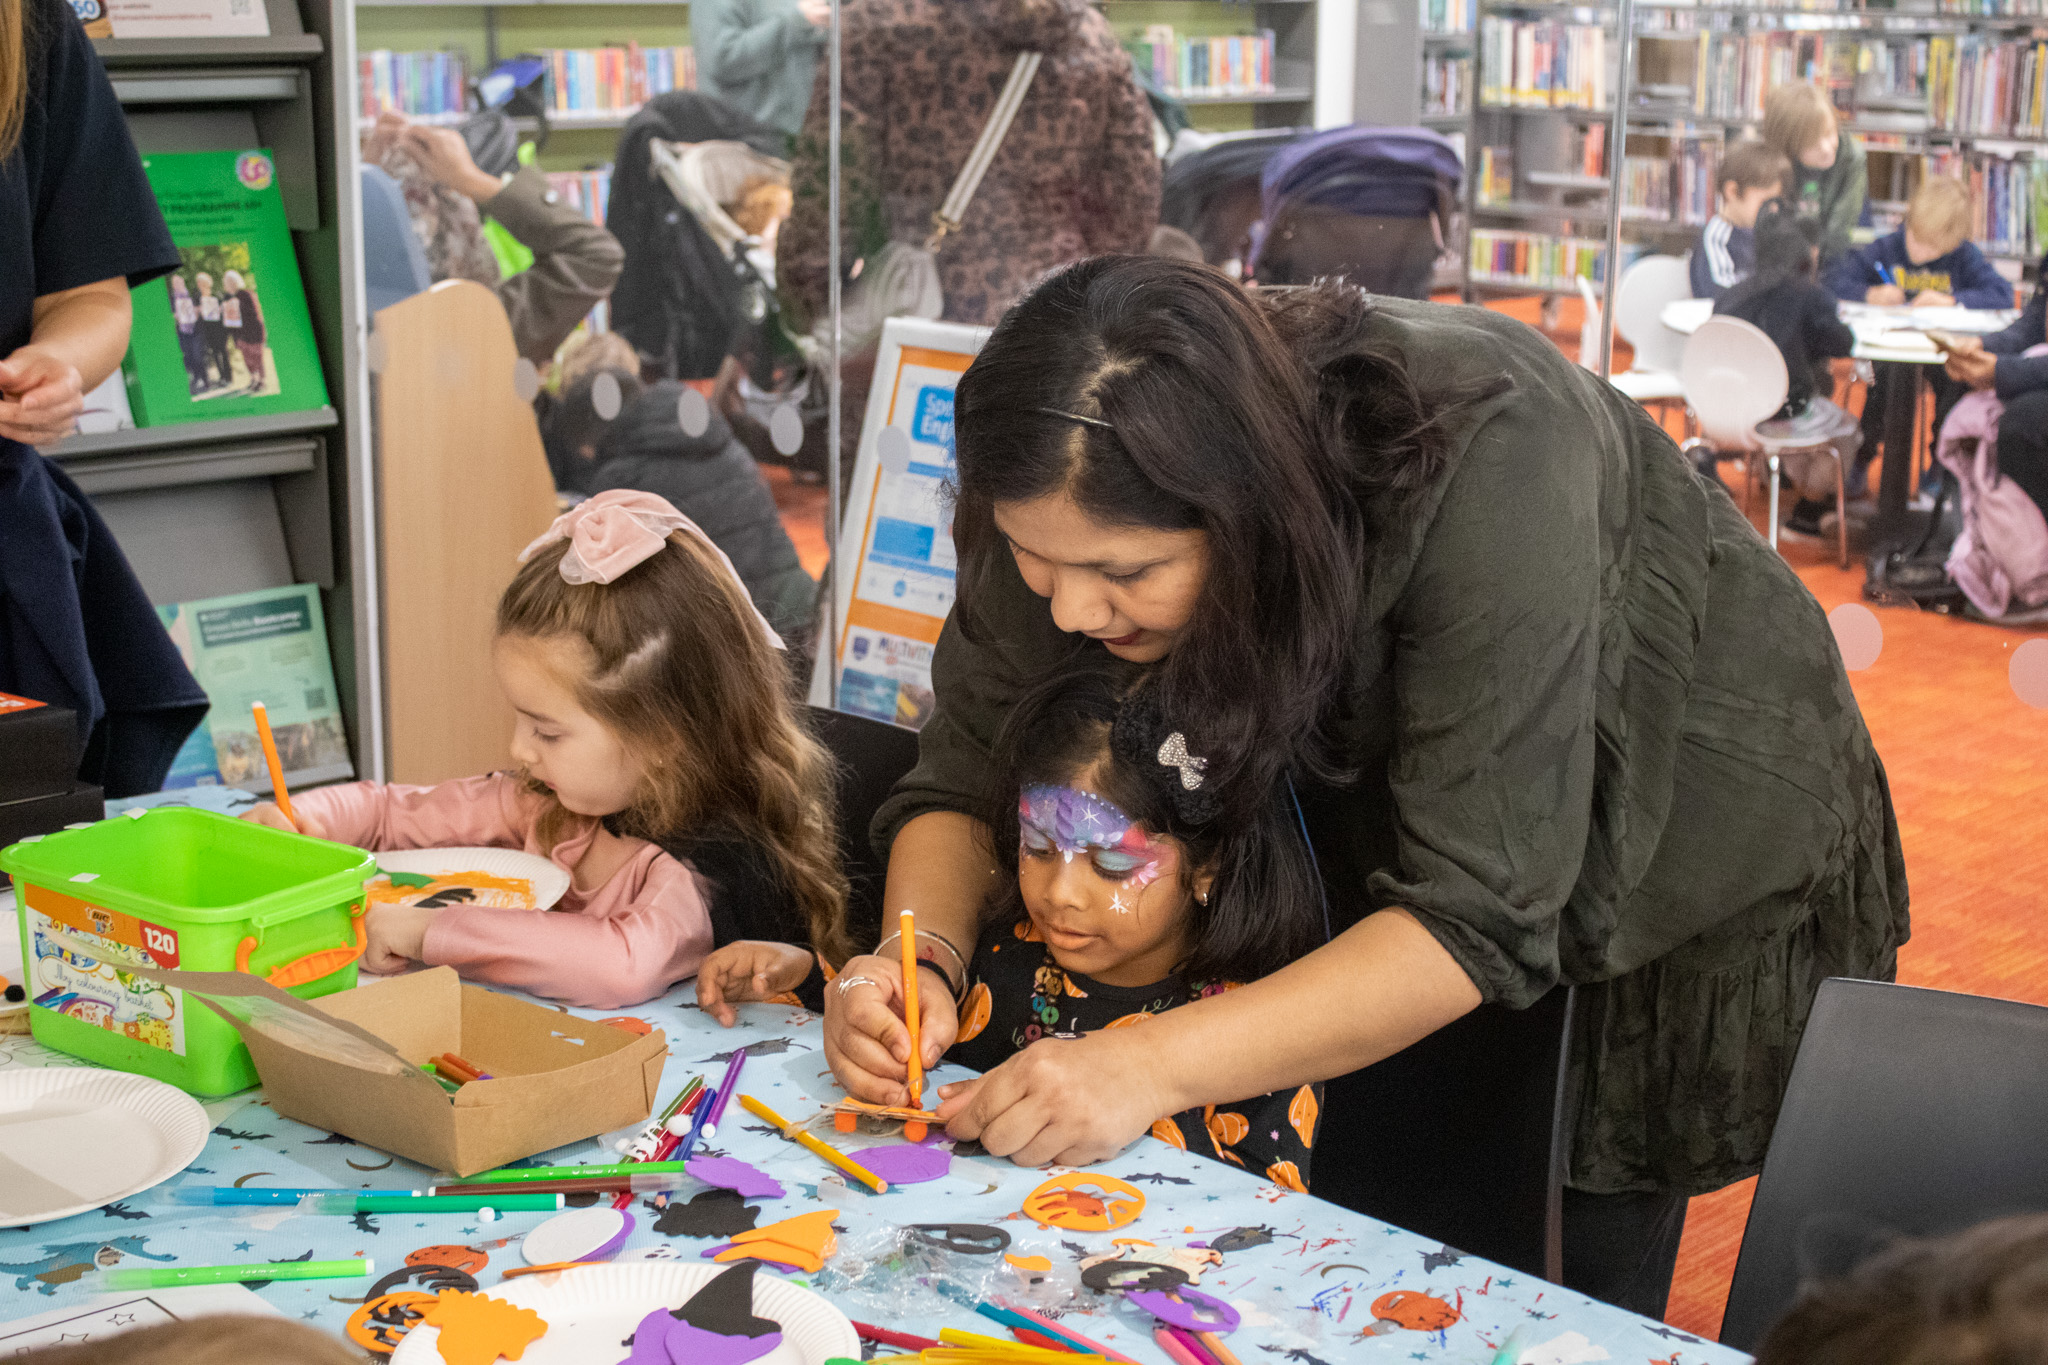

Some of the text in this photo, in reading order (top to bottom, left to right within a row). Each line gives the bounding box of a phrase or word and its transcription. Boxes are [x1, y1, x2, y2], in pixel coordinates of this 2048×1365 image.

[144, 927, 175, 955] 120
[76, 973, 122, 1009] colouring
[123, 985, 154, 1012] basket
